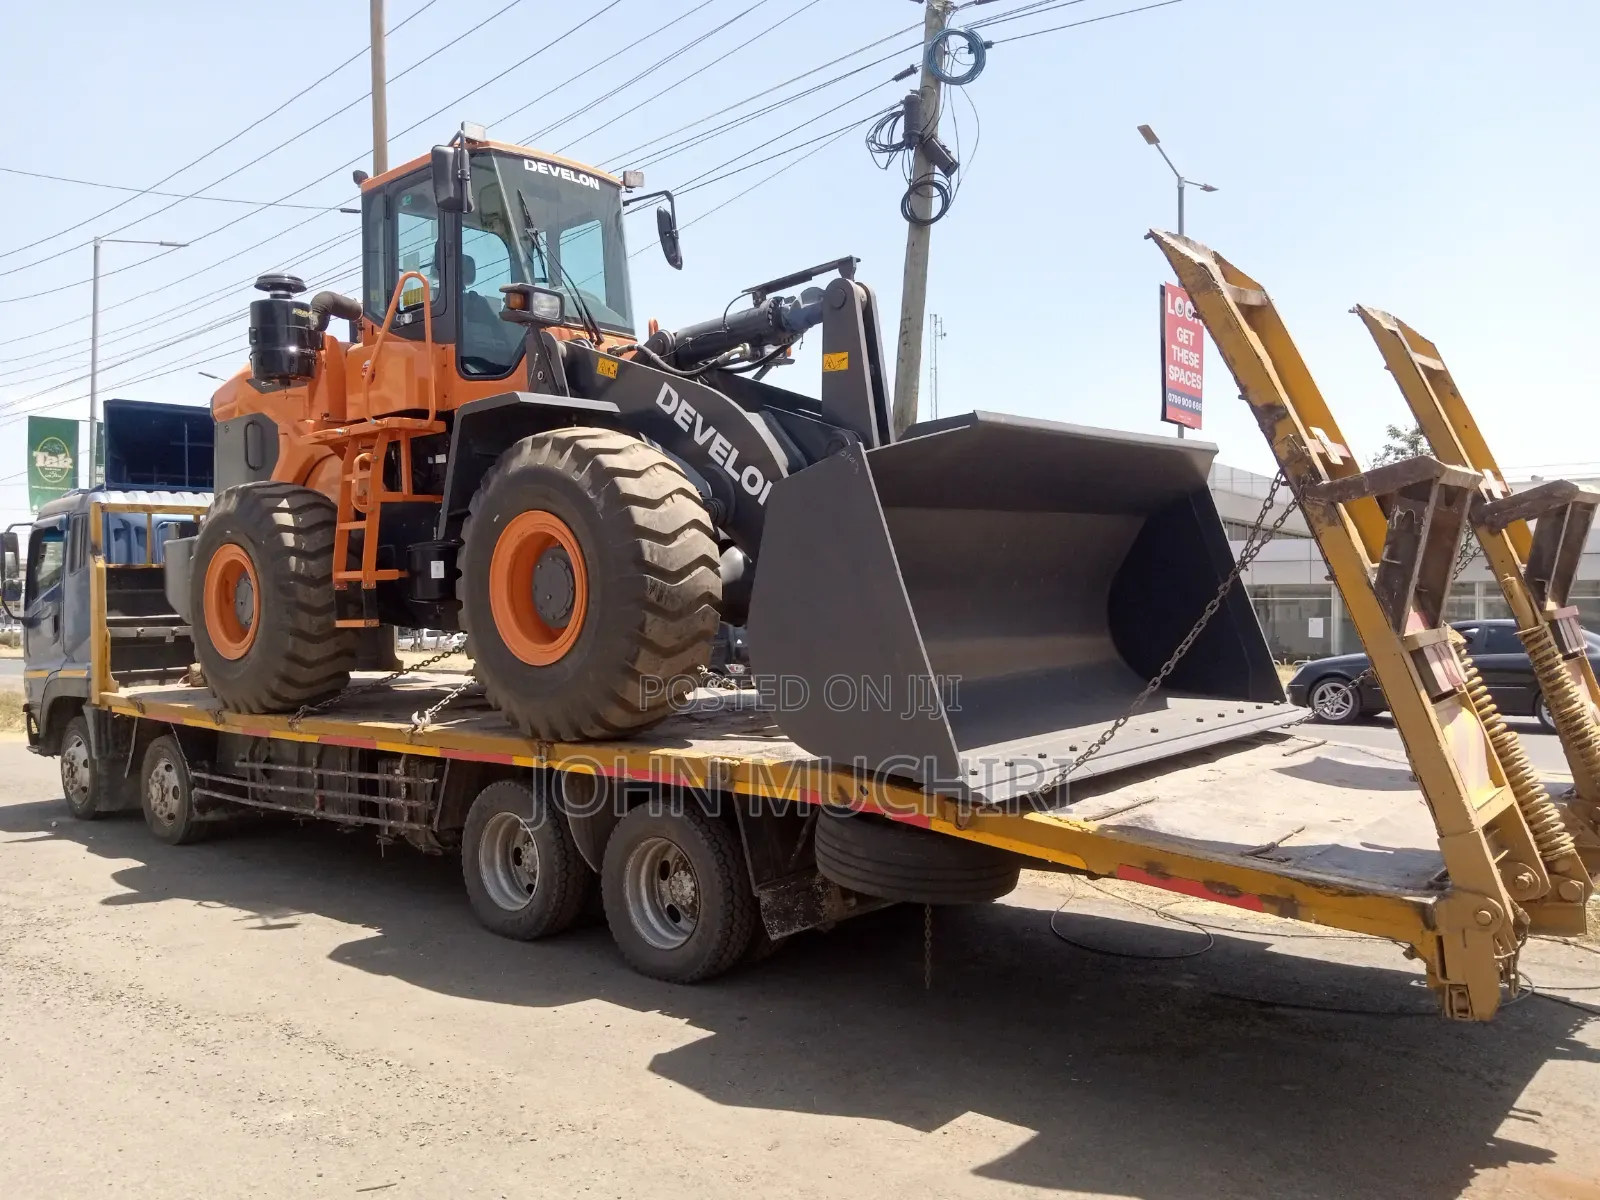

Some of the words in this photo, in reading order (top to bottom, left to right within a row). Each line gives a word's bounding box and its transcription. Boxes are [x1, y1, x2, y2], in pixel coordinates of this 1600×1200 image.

[524, 159, 600, 190] DEVELON
[1177, 327, 1195, 346] GET
[1172, 345, 1200, 369] THESE
[1168, 364, 1202, 390] SPACES
